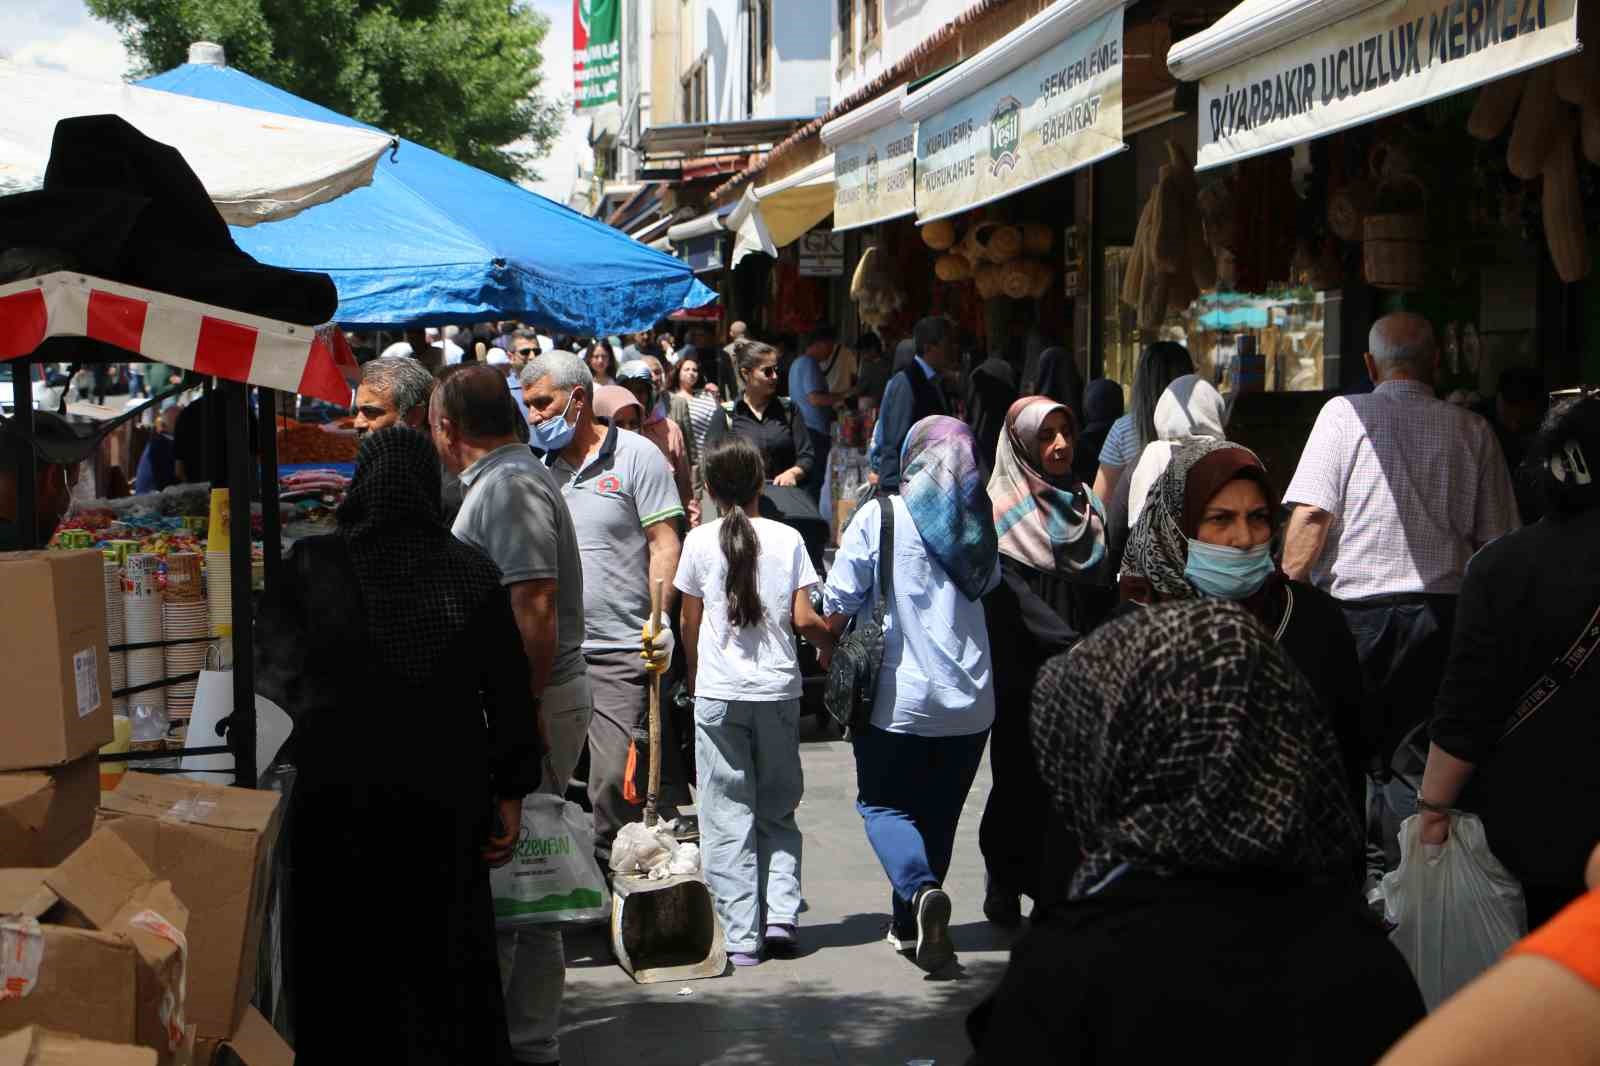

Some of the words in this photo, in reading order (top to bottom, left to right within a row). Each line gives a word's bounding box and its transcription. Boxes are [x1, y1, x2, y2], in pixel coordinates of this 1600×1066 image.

[1210, 62, 1316, 142] DİYARBAKIR
[1320, 16, 1423, 106] UCUZLUK
[991, 113, 1019, 152] Yeşil
[1042, 98, 1101, 145] BAHARAT
